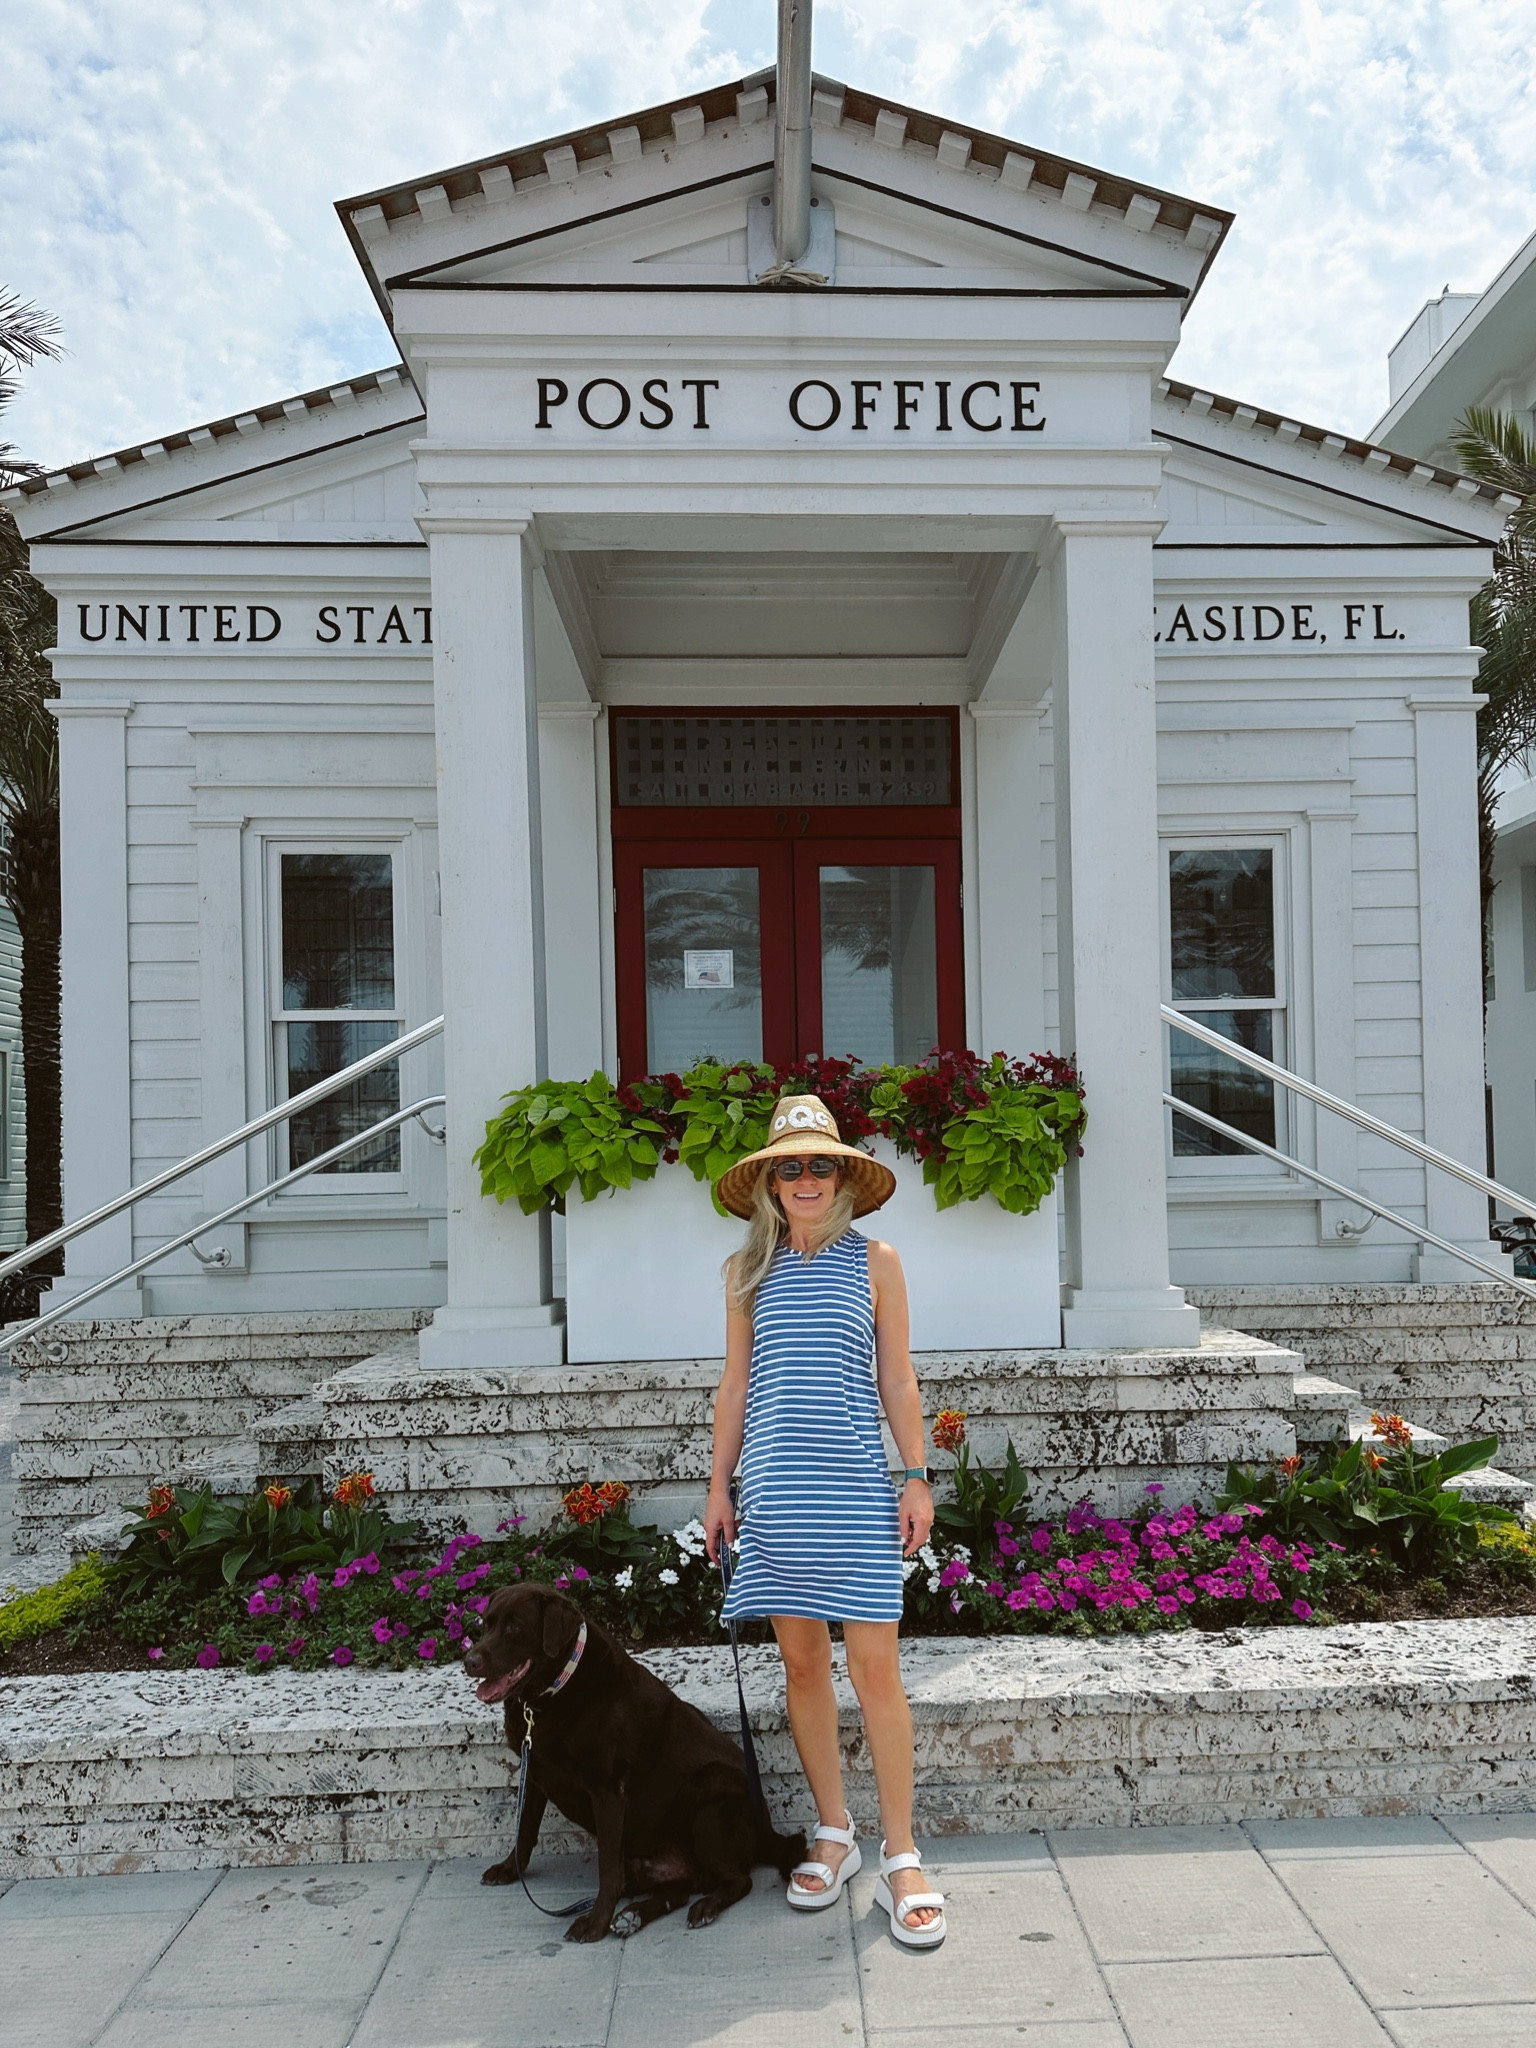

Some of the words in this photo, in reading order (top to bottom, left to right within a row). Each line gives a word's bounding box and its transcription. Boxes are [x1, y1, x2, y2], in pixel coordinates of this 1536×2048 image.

[534, 378, 720, 430] POST
[788, 379, 1047, 432] OFFICE
[77, 604, 282, 642] UNITED
[316, 604, 433, 644] STAT
[1154, 603, 1327, 645] ASIDE,
[1343, 604, 1406, 640] FL.
[668, 758, 790, 777] CONAC
[638, 782, 698, 798] SAT
[873, 782, 935, 797] 32459
